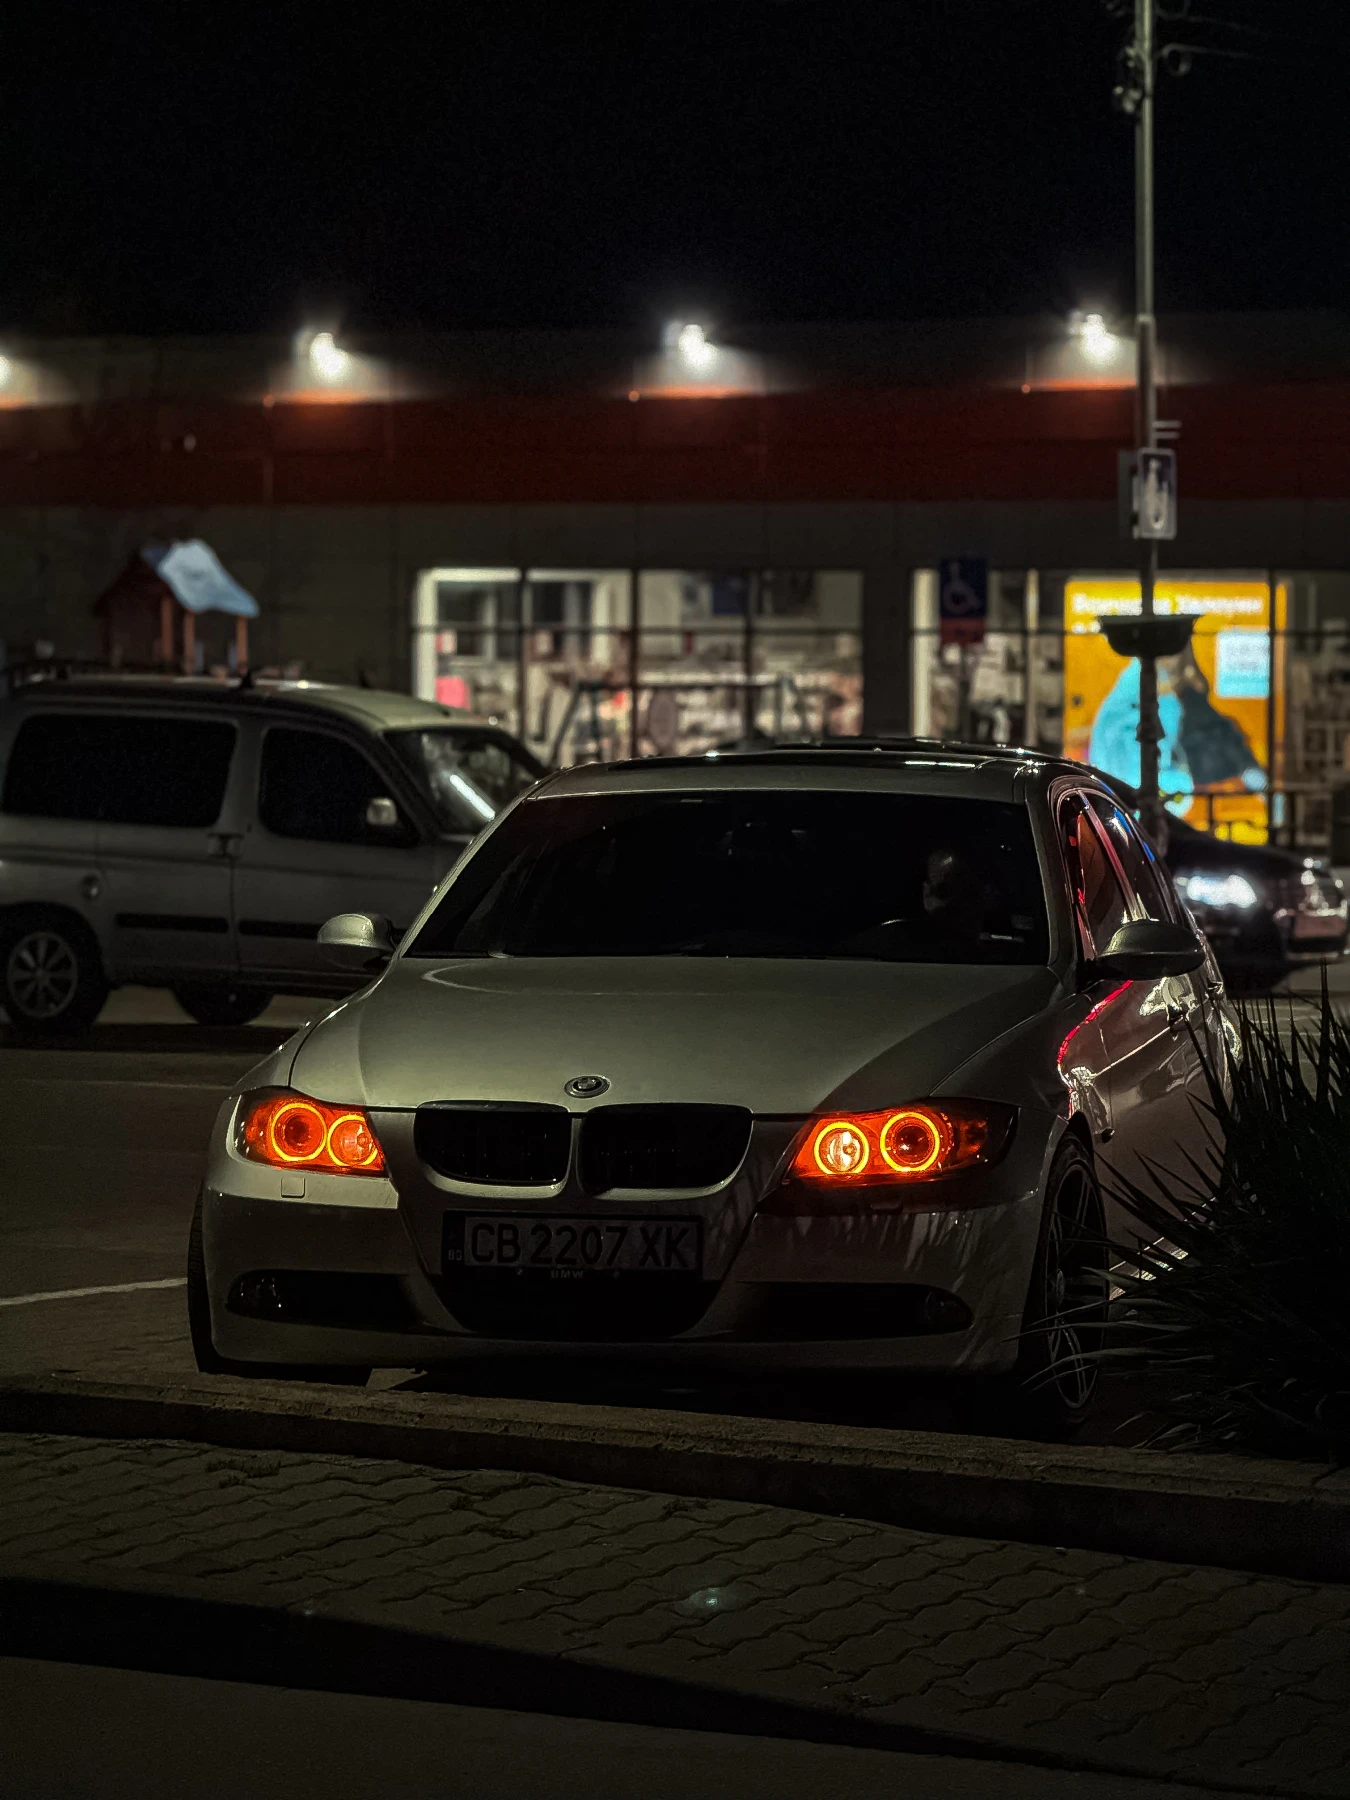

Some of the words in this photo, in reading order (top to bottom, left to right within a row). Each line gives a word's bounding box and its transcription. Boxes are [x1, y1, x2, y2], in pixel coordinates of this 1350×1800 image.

[472, 1223, 520, 1263] CB
[530, 1224, 628, 1266] 2207
[639, 1226, 690, 1268] XK
[550, 1270, 585, 1280] BMW
